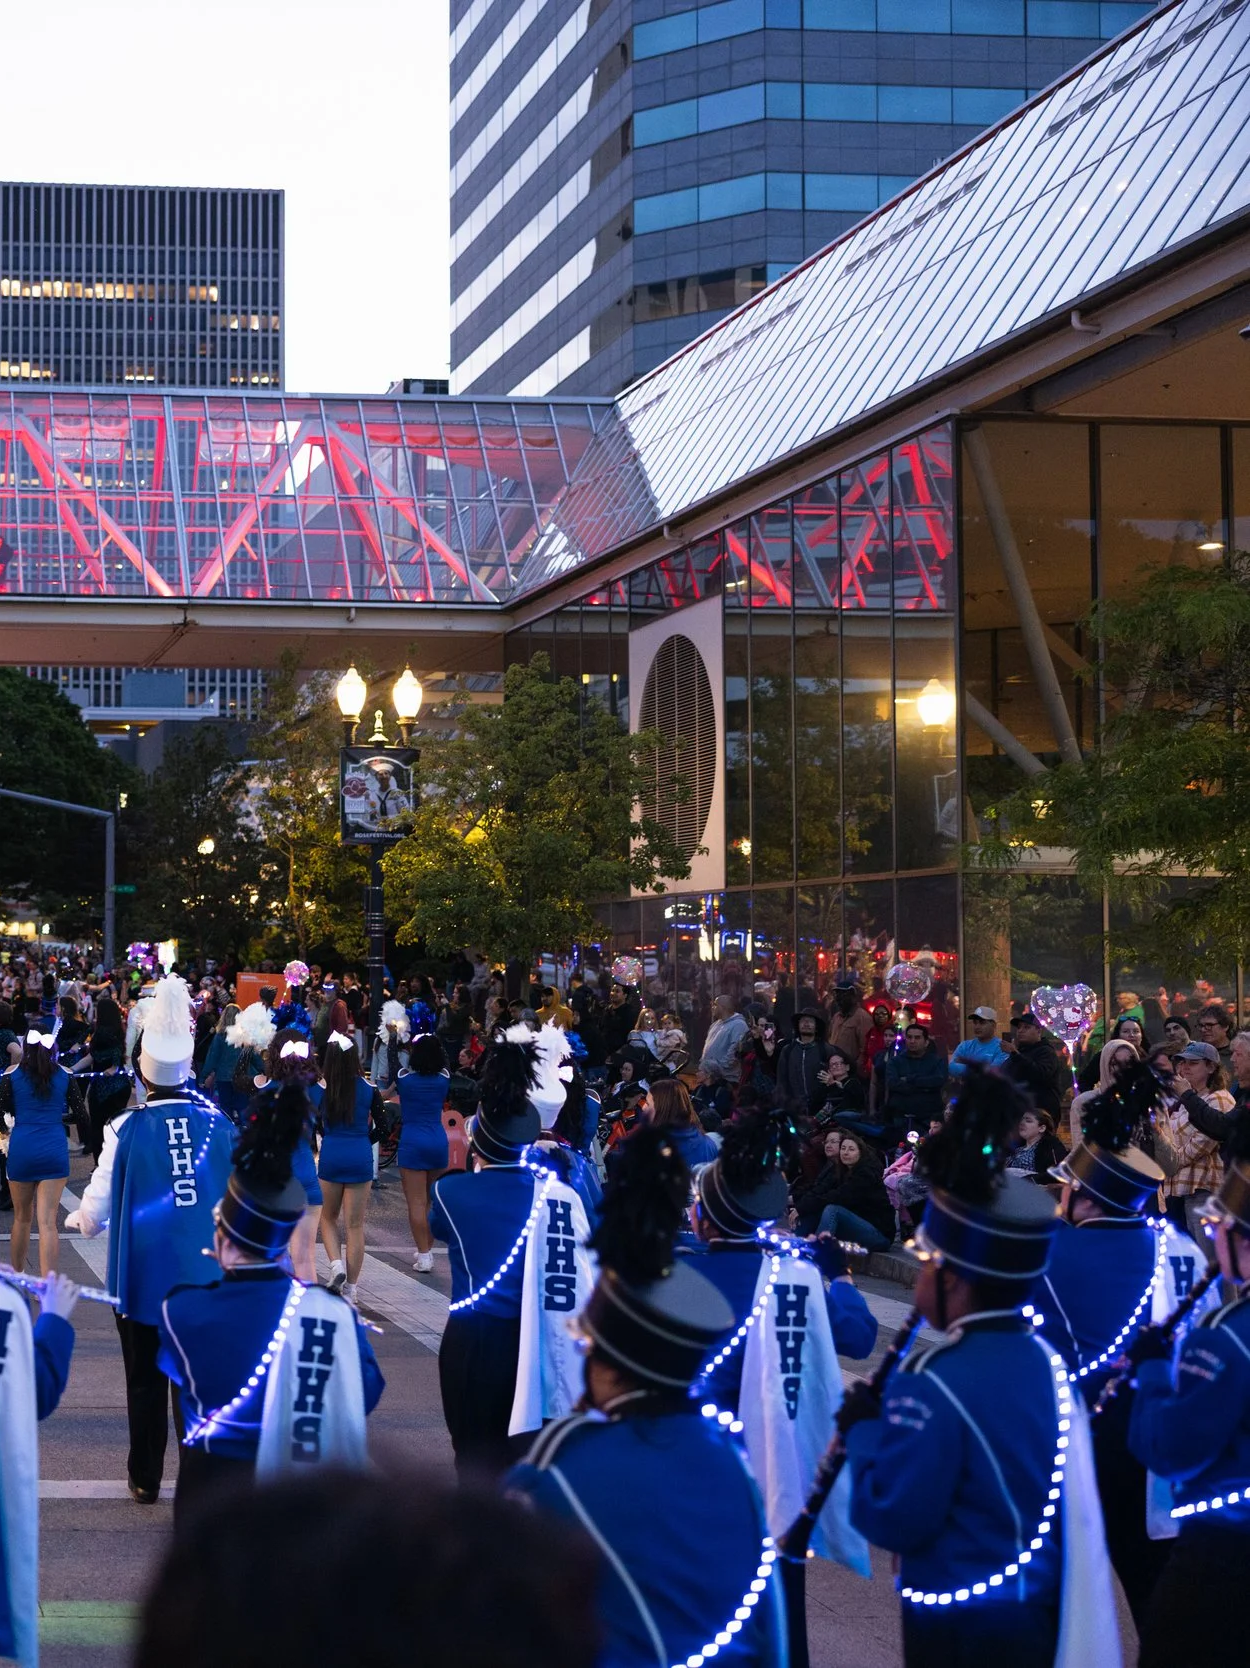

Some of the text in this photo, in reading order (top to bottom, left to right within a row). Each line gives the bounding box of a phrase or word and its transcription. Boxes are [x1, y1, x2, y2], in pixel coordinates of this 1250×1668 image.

[164, 1117, 198, 1208] HHS
[544, 1198, 577, 1312] HHS
[1168, 1255, 1195, 1302] H
[291, 1316, 337, 1462] HHS
[773, 1283, 810, 1420] HHS
